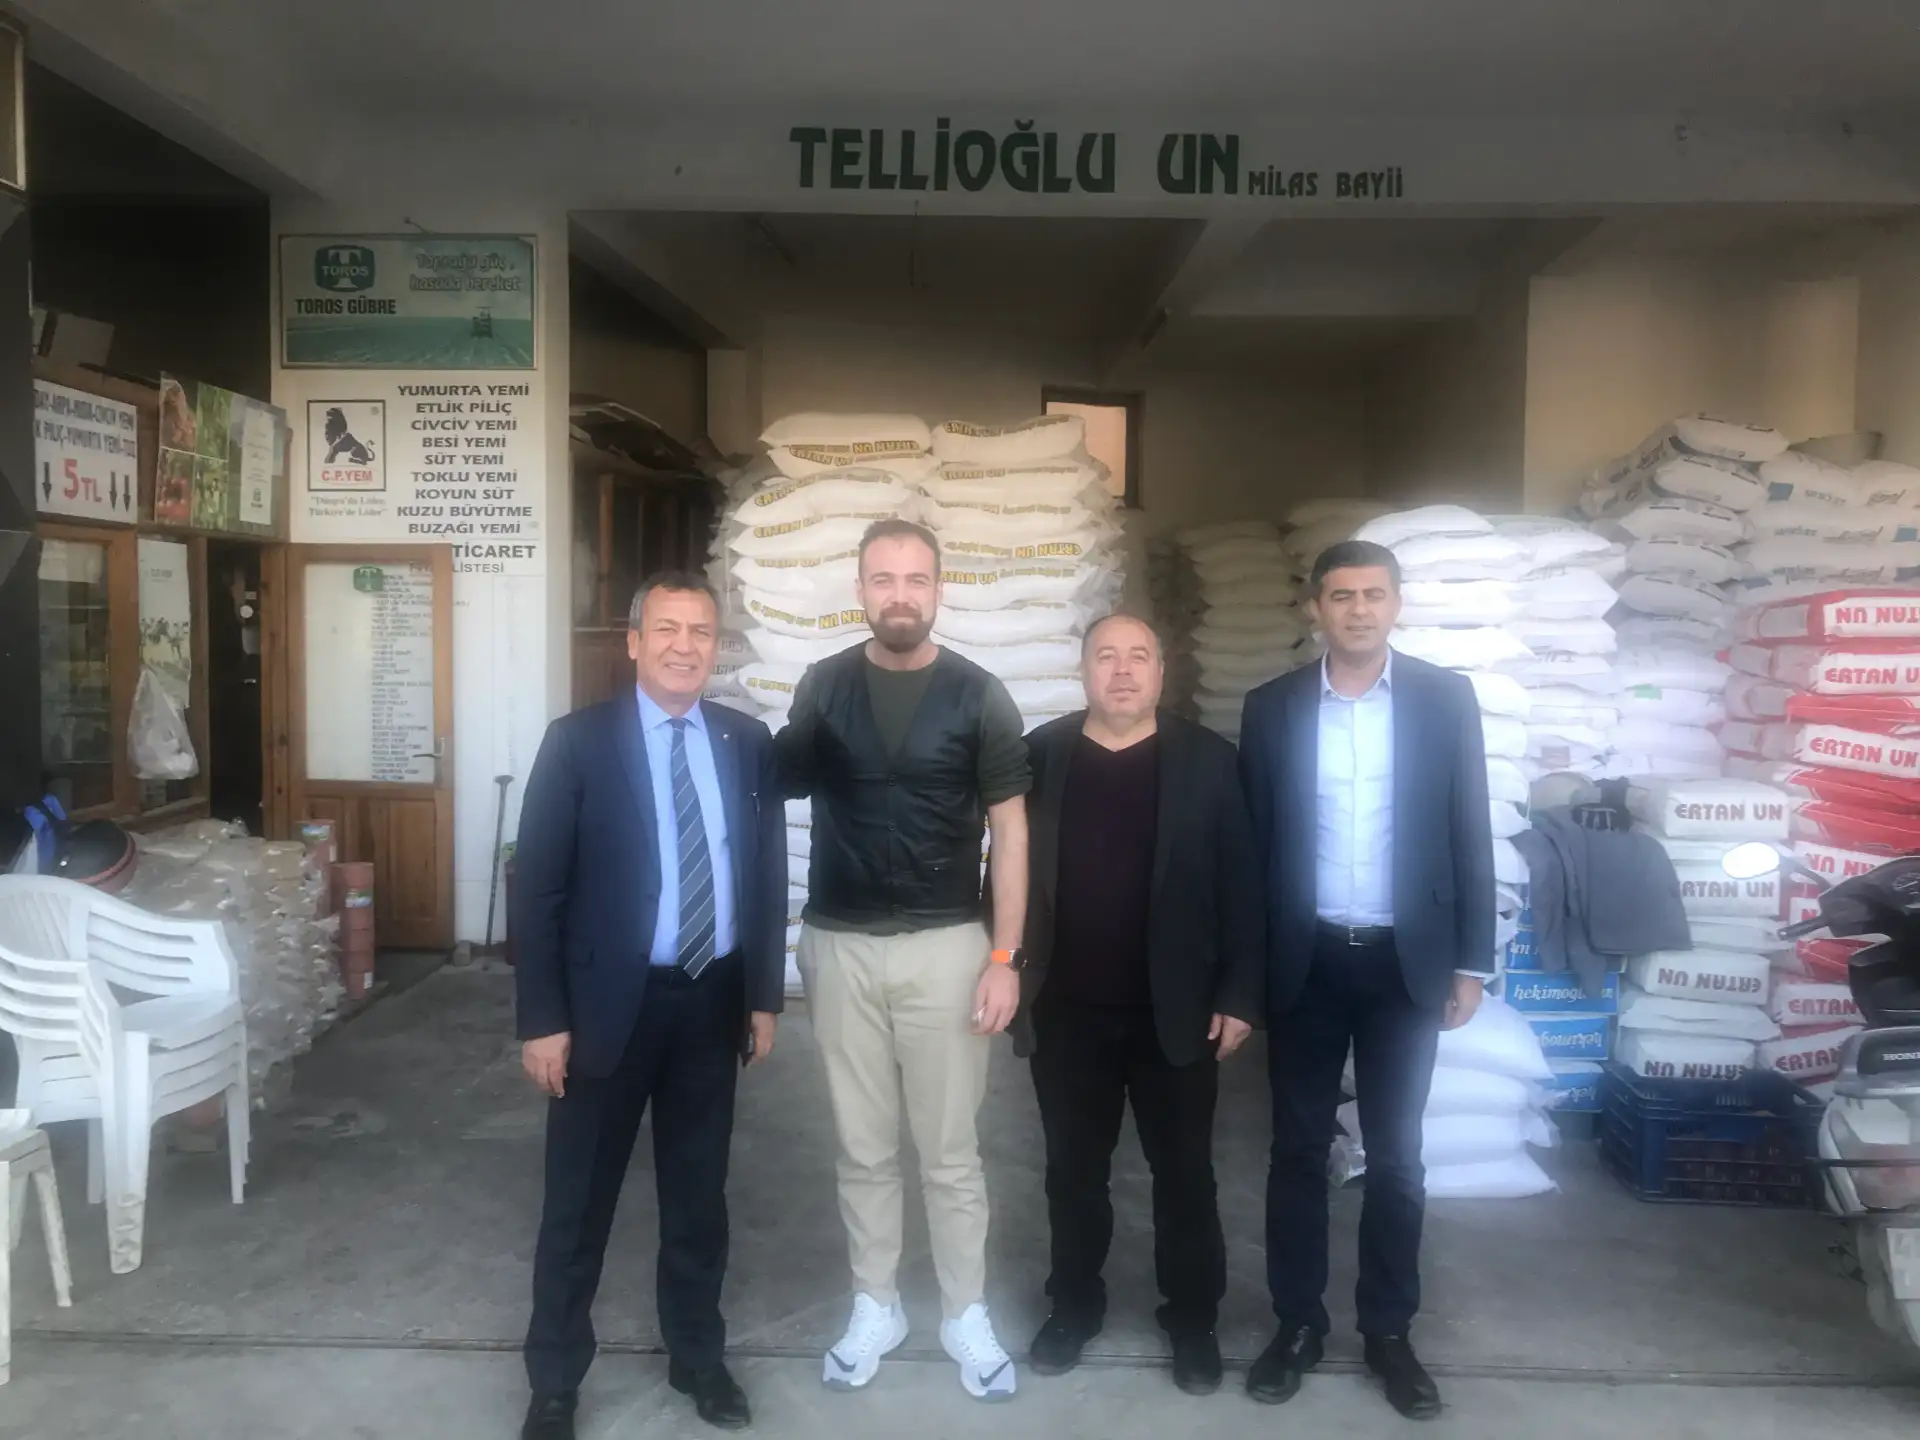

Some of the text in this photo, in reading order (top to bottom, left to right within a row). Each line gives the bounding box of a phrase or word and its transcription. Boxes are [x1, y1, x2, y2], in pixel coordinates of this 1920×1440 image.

[789, 117, 1115, 194] TELLİOĞLU
[1157, 134, 1239, 194] UN
[1248, 165, 1319, 197] MİLAS
[321, 264, 369, 277] TOROS
[296, 295, 397, 314] TOROS GÜBRE
[397, 382, 530, 396] YUMURTA YEMİ
[415, 400, 512, 416] ETLİK PİLİÇ
[411, 418, 517, 431] CİVCİV YEMİ
[421, 435, 507, 448] BESİ YEMİ
[424, 452, 504, 465] SÜT YEMİ
[62, 458, 102, 503] 5 TL
[412, 469, 518, 483] TOKLU YEMİ
[415, 487, 515, 500] KOYUN SÜT
[397, 504, 533, 517] KUZU BÜYÜTME
[408, 520, 521, 534] BUZAĞI YEMİ
[452, 541, 536, 559] TİCARET
[452, 562, 504, 574] LİSTESİ
[940, 571, 977, 585] RTAN
[1836, 607, 1920, 624] TAN UN
[1825, 667, 1920, 684] ERTAN U
[1810, 737, 1918, 768] ERTAN UN
[1674, 803, 1782, 820] ERTAN UN
[1681, 881, 1775, 898] RTAN UN
[1657, 968, 1762, 993] ERTAN UN
[1644, 1061, 1675, 1078] UN
